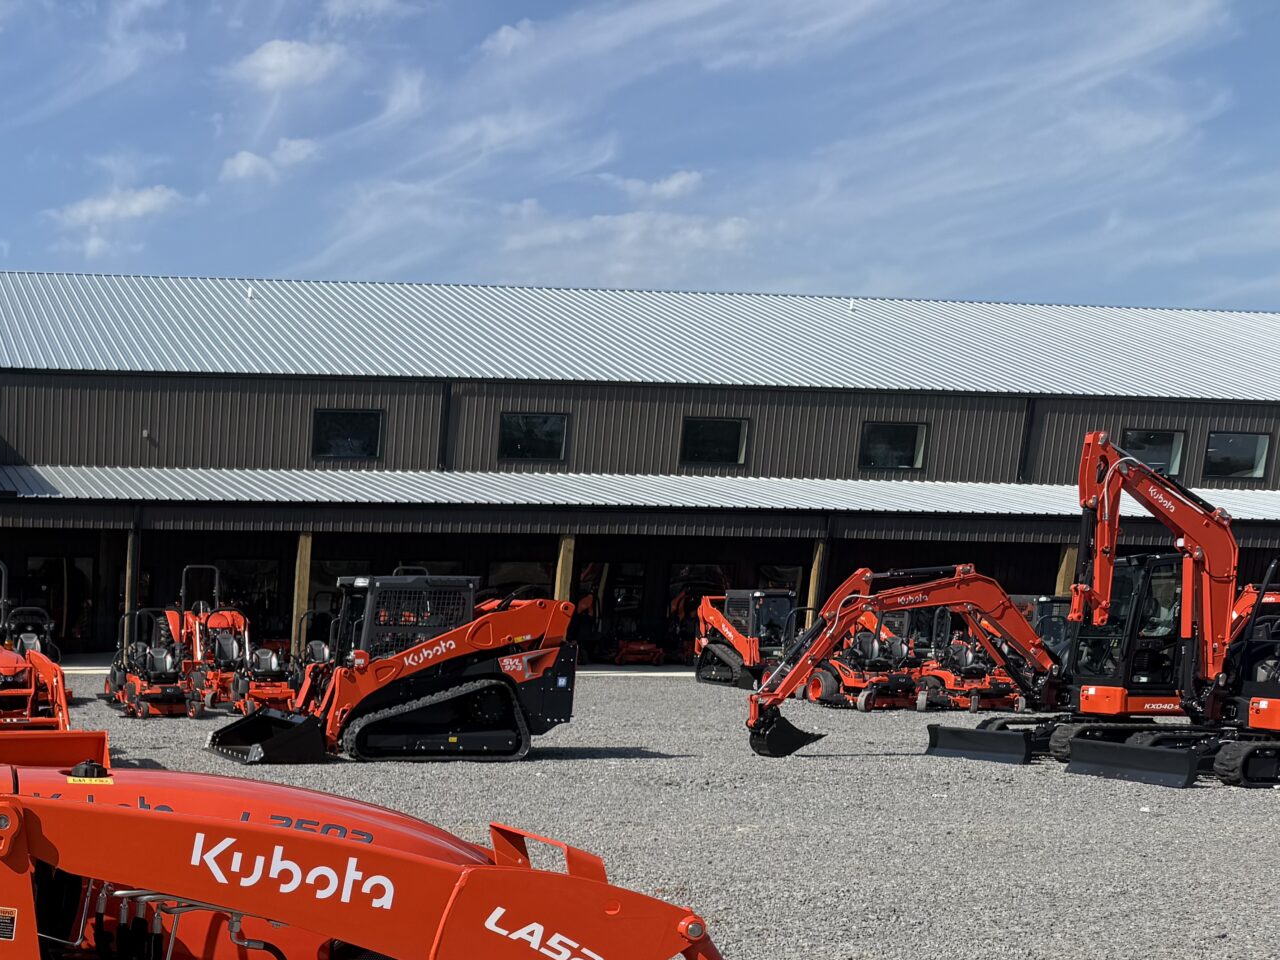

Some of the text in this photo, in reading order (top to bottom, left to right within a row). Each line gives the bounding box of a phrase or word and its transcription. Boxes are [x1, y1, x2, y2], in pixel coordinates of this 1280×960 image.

[1148, 485, 1175, 512] Kubota
[897, 594, 928, 605] Kubota
[403, 640, 456, 666] Kubota
[501, 658, 522, 666] SVL
[190, 832, 395, 910] Kubota
